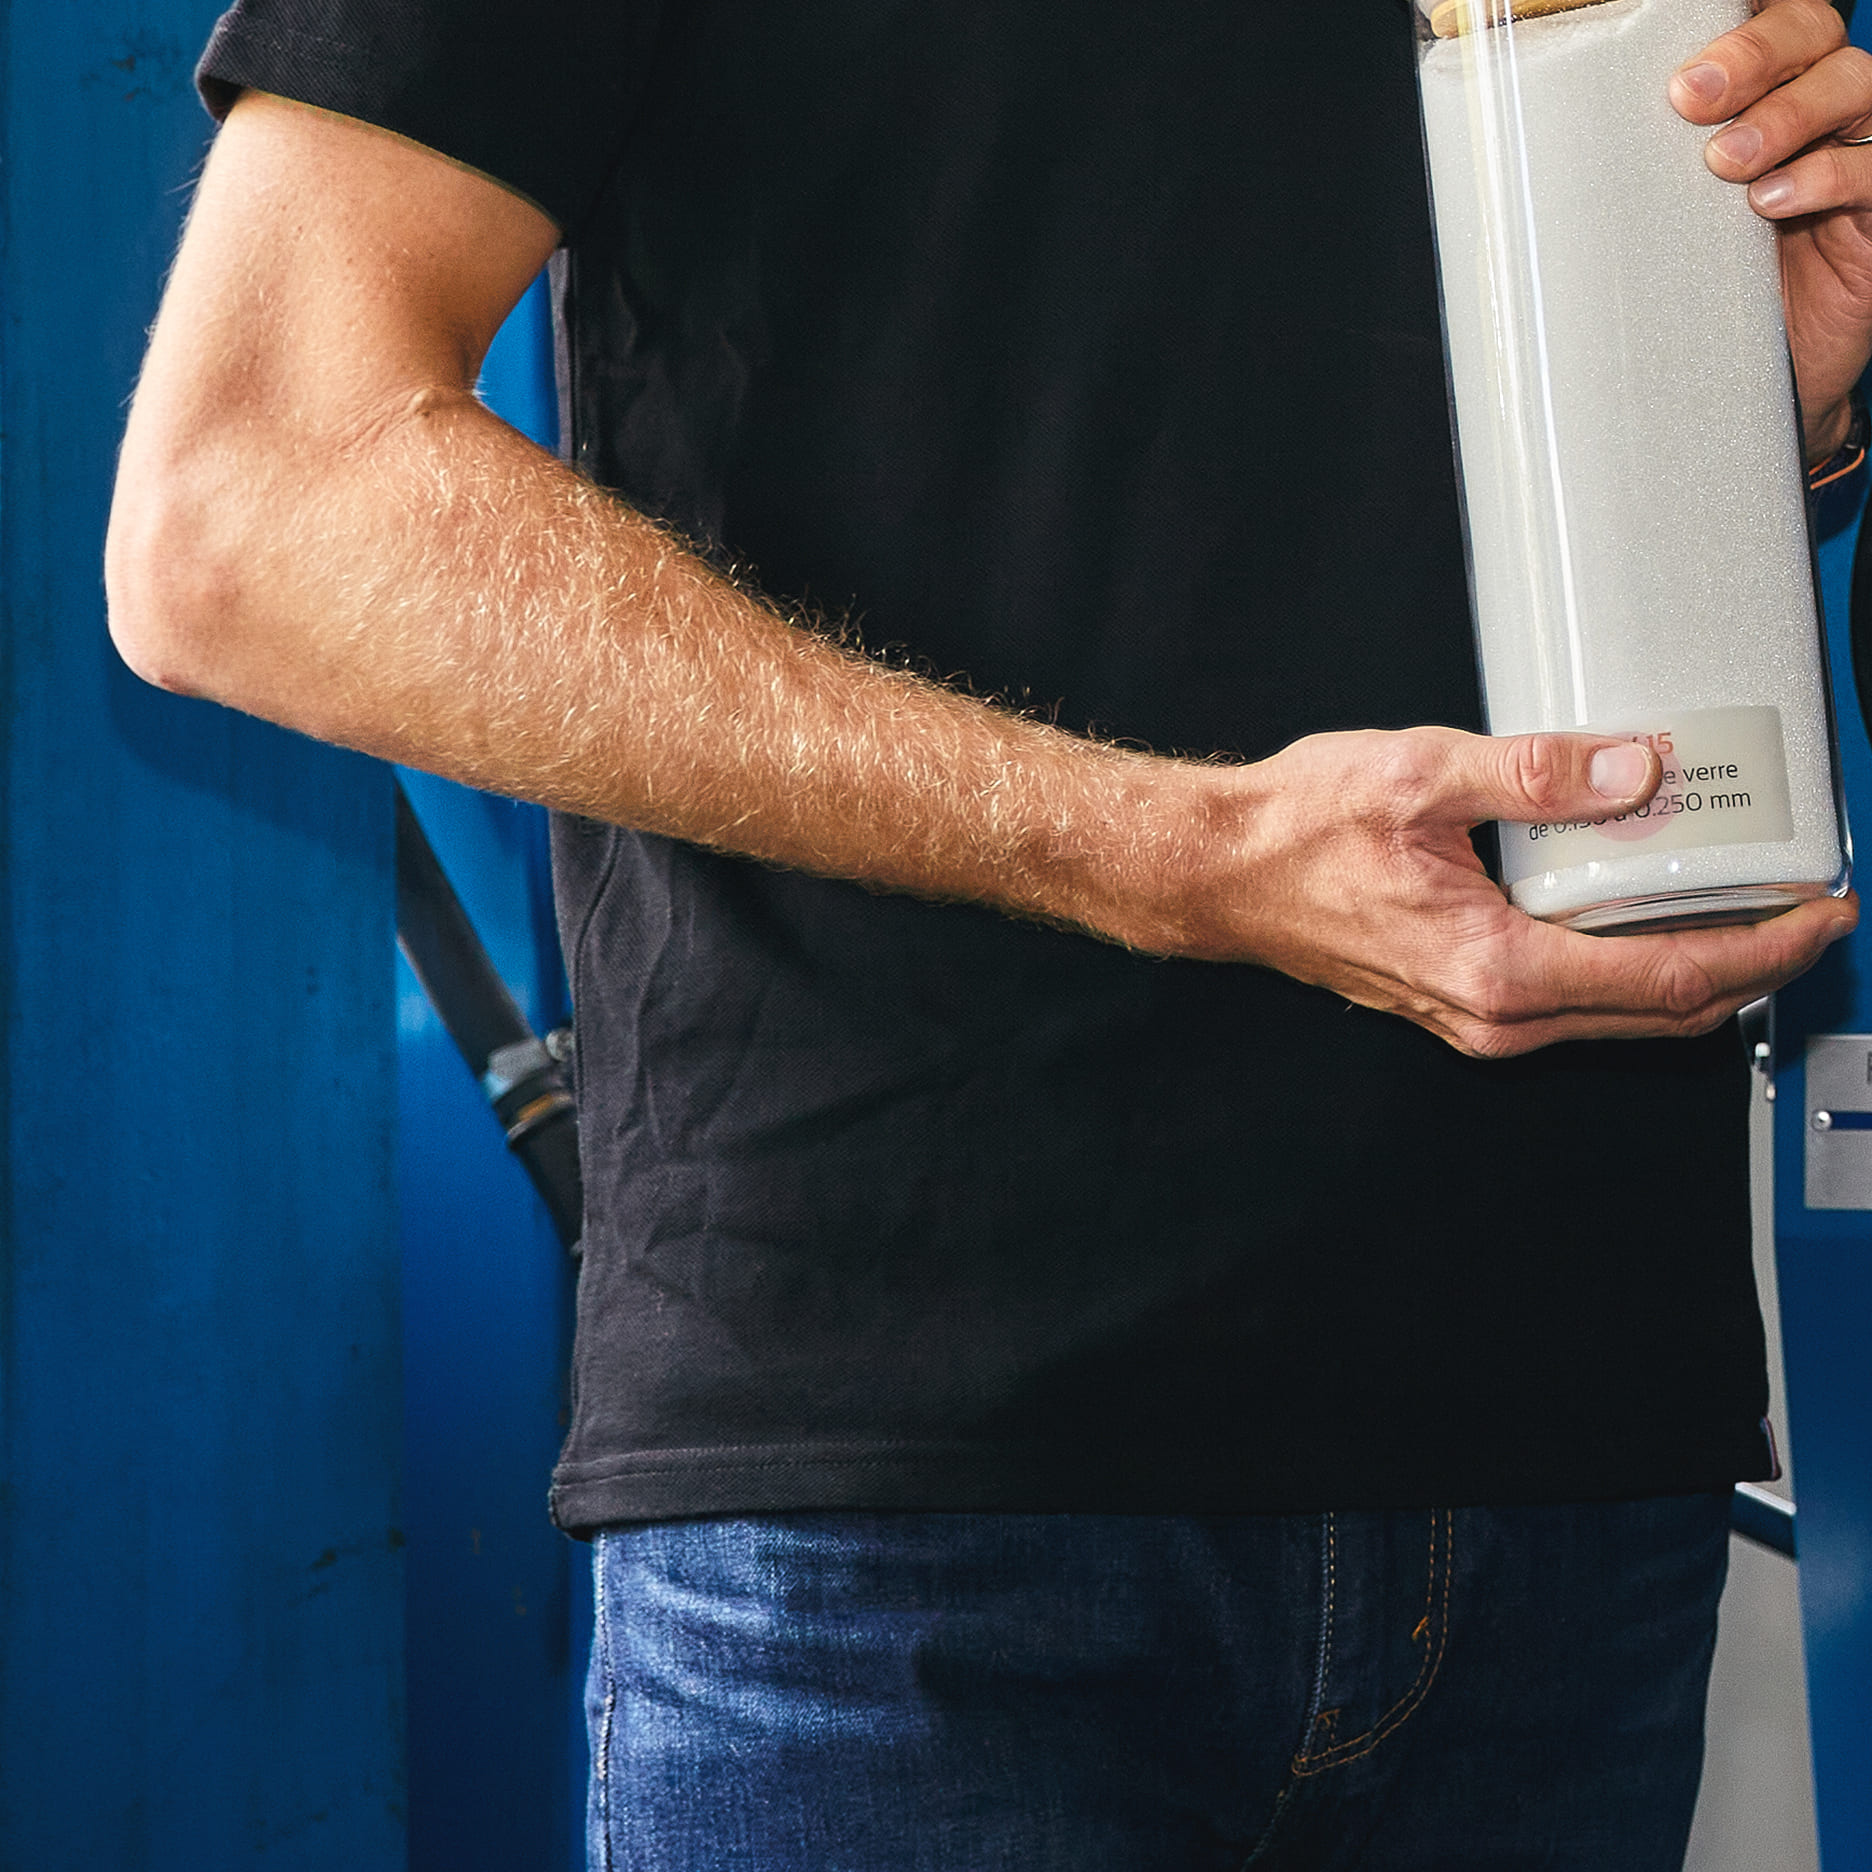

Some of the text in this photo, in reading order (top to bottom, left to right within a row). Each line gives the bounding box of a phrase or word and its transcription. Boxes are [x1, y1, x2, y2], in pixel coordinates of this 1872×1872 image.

[1632, 732, 1674, 755] 15
[1682, 763, 1739, 783] verre
[1710, 791, 1752, 810] mm
